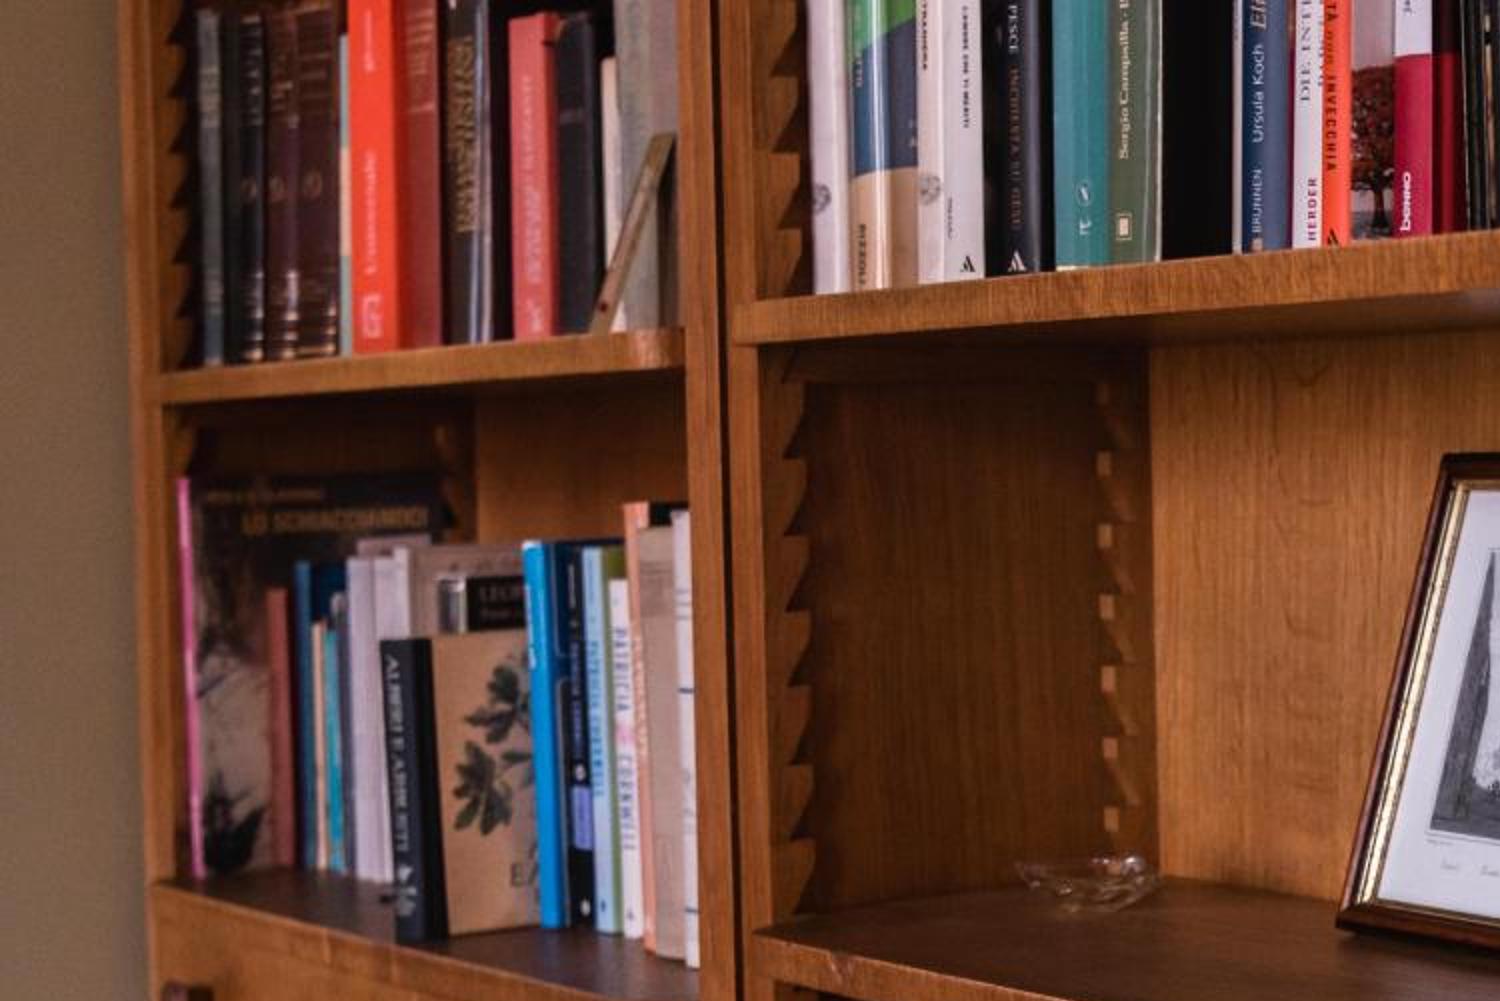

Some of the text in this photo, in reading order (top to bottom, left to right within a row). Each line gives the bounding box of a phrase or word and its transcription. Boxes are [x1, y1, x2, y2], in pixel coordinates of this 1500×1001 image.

[1251, 43, 1265, 85] Koch
[1300, 0, 1311, 101] DIE INT
[1118, 108, 1131, 160] Sergio
[1251, 91, 1265, 143] Ursula
[1325, 75, 1337, 171] INVECCHIA
[1251, 168, 1264, 233] BRUNNEN
[1306, 177, 1318, 241] HERDER
[1400, 171, 1412, 231] benno
[614, 627, 636, 851] PATRICIA CORNWELL
